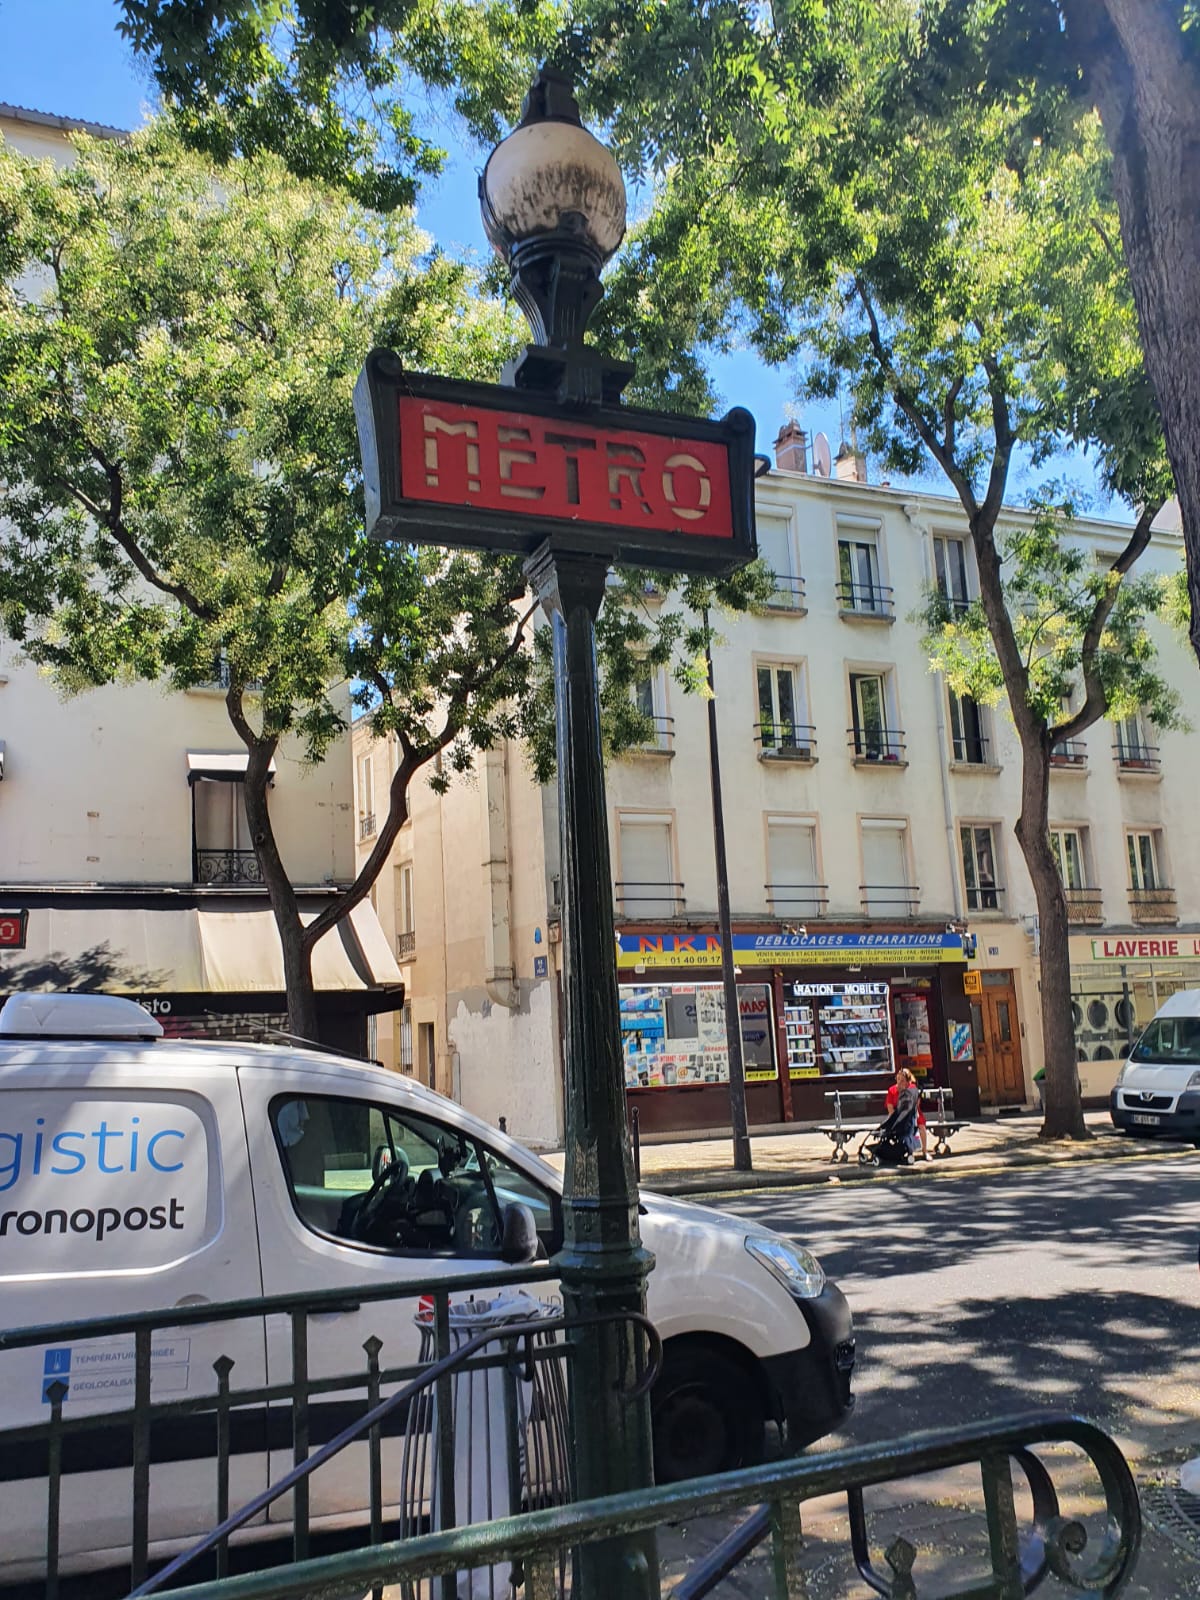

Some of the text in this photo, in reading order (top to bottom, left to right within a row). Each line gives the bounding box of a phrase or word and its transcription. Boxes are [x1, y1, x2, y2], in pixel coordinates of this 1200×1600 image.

[423, 414, 711, 520] METRO
[1104, 940, 1179, 957] LAVERIE
[844, 984, 879, 994] MOBILE
